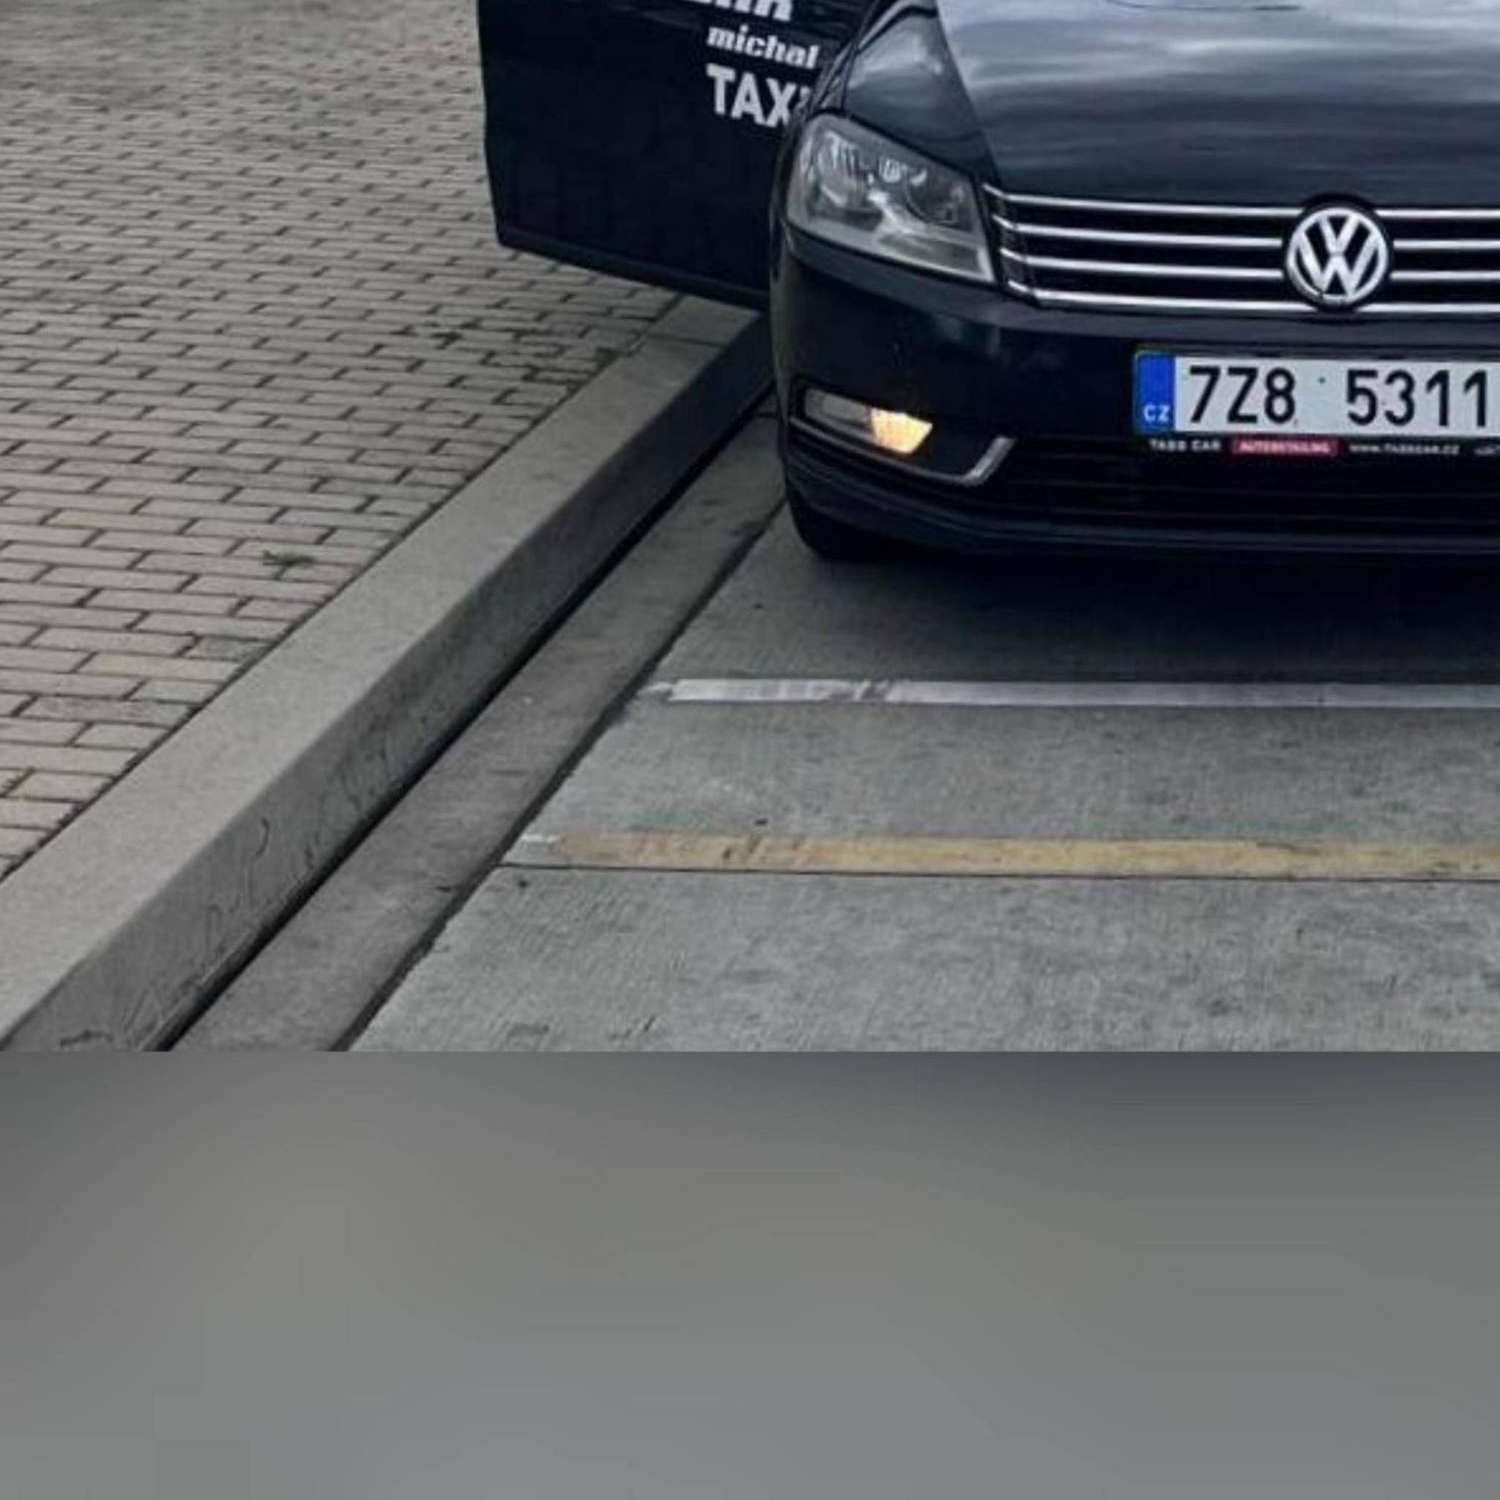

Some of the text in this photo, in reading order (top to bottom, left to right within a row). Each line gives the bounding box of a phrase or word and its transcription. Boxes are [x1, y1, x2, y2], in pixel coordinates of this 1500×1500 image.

[706, 24, 820, 70] michal
[1143, 405, 1171, 423] CZ
[1188, 365, 1488, 428] 7Z8 5311
